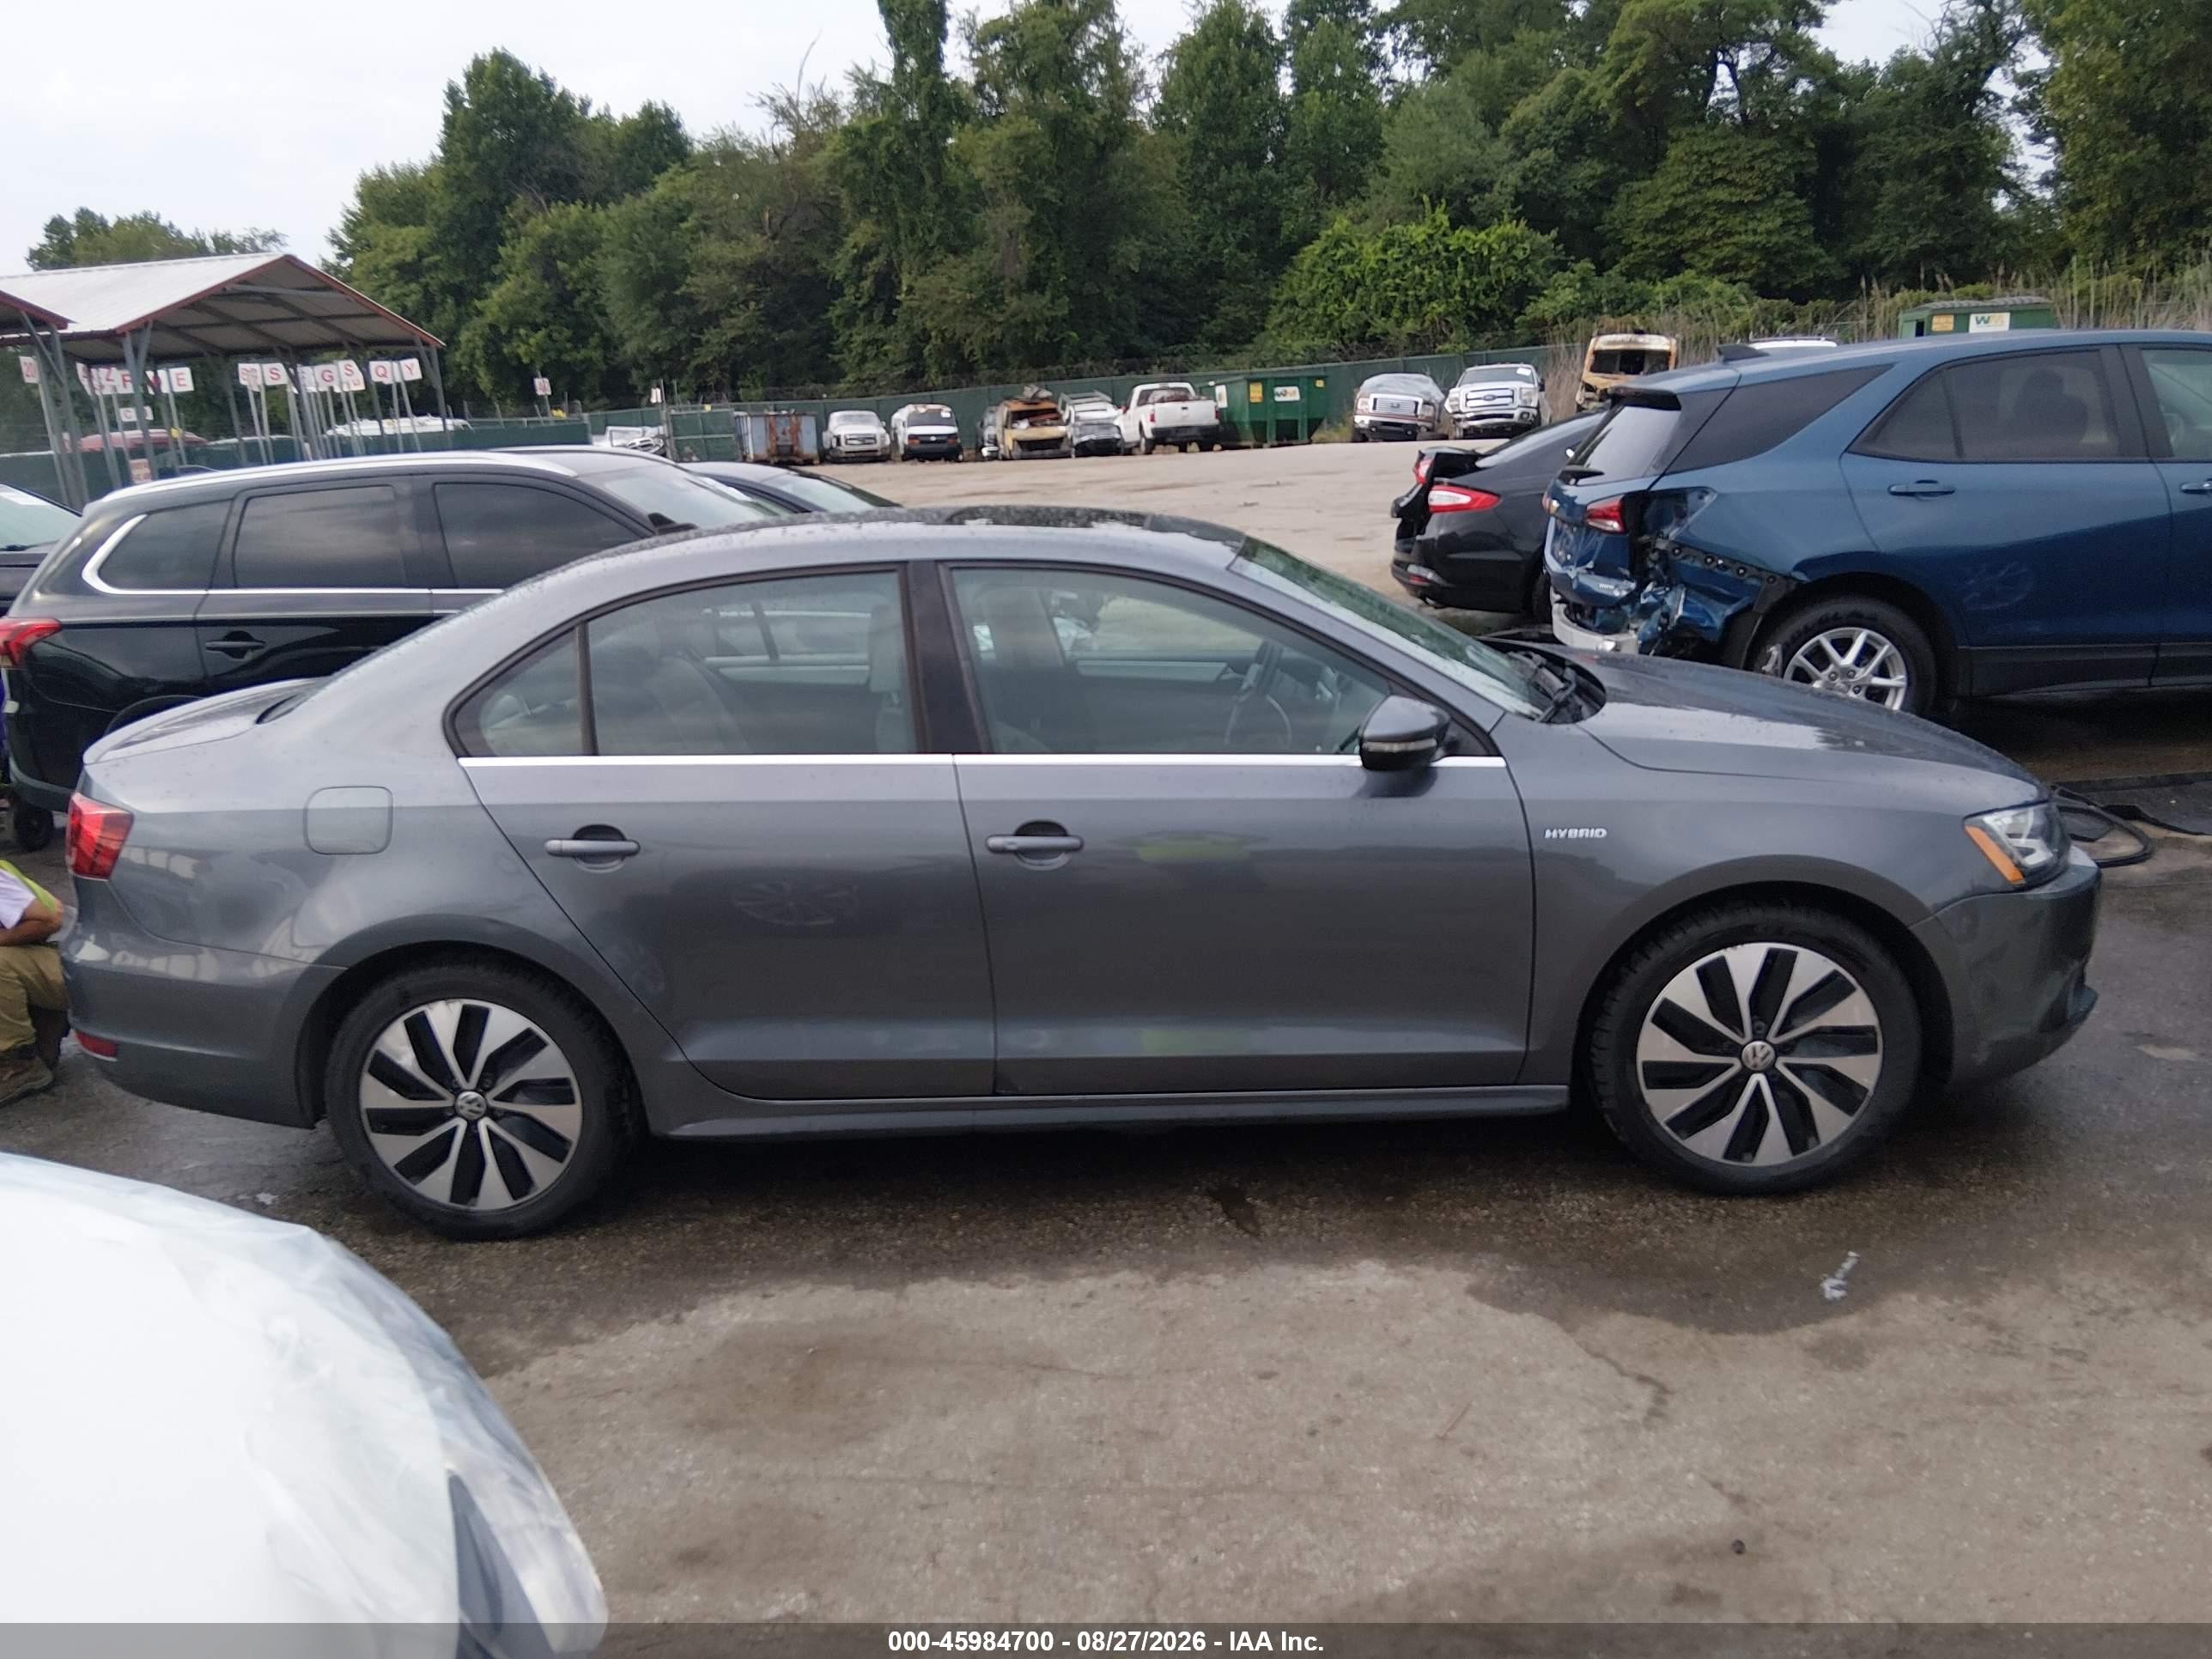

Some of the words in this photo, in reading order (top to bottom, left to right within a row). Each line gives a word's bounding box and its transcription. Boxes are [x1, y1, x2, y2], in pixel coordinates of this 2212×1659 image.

[269, 367, 282, 381] S
[320, 369, 334, 383] G
[343, 363, 355, 377] S
[375, 365, 388, 379] Q
[404, 362, 415, 377] Y
[176, 371, 187, 388] E
[1544, 828, 1607, 839] HYBRID
